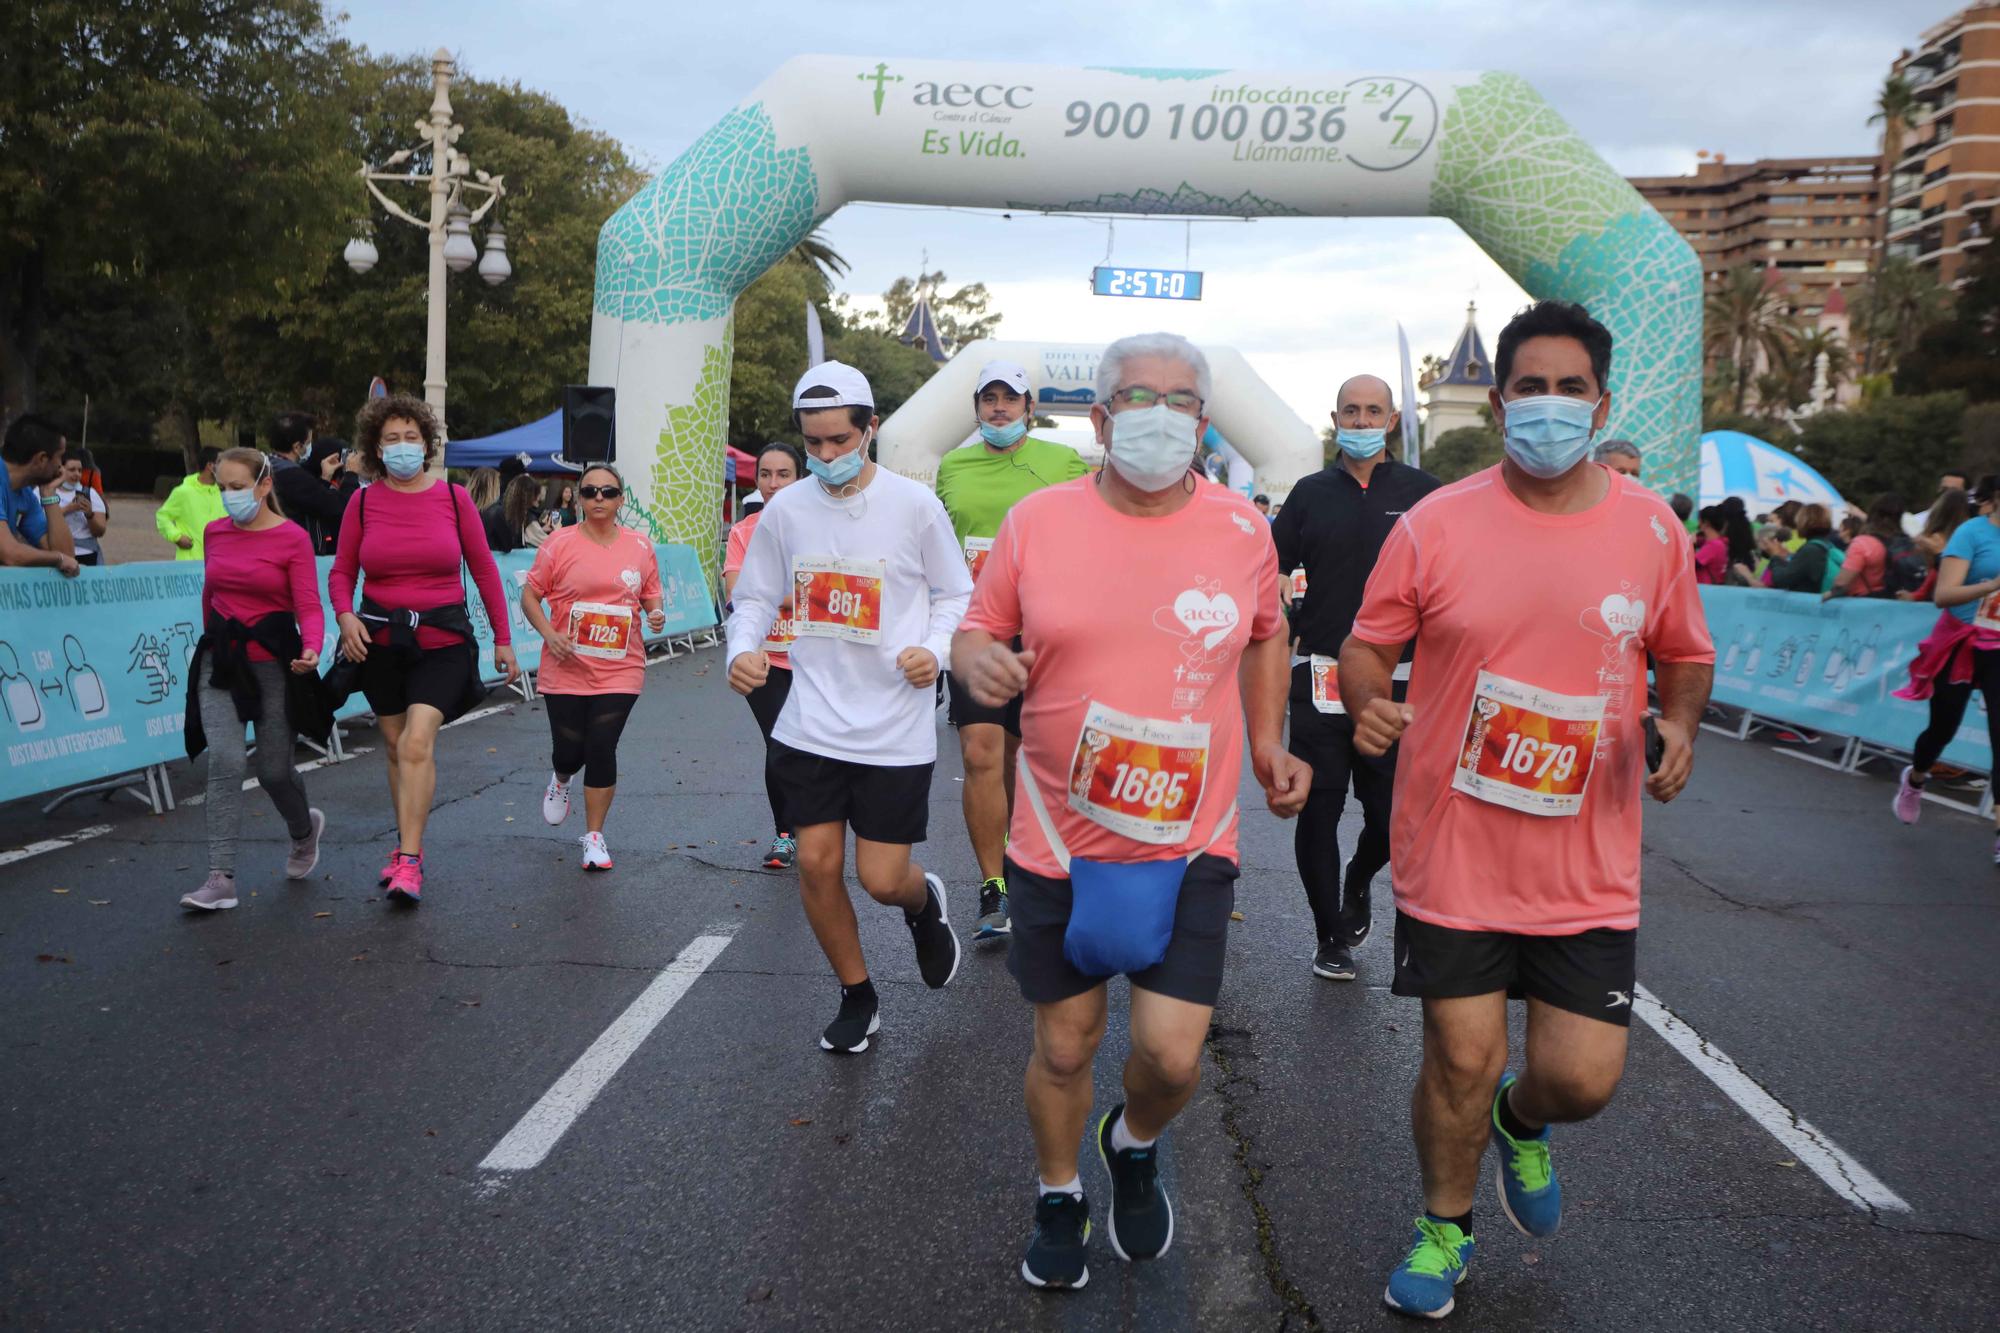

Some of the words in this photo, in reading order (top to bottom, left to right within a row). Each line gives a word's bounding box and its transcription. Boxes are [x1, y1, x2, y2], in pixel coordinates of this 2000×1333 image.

[913, 81, 1034, 109] aecc
[1210, 84, 1351, 105] infocáncer
[1363, 82, 1395, 98] 24
[933, 110, 965, 123] Contra
[969, 111, 978, 123] el
[1064, 100, 1150, 139] 900
[1168, 103, 1248, 142] 100
[1260, 105, 1347, 143] 036
[1390, 115, 1413, 145] 7
[921, 129, 950, 154] Es
[959, 130, 1026, 158] Vida.
[1232, 140, 1343, 163] Llámame.
[33, 580, 72, 608] COVID
[74, 579, 90, 606] DE
[91, 575, 153, 604] SEGURIDAD
[154, 575, 164, 600] E
[163, 573, 204, 599] HIGIEN
[828, 588, 862, 619] 861
[1184, 608, 1235, 625] aecc
[588, 623, 619, 643] 1126
[8, 736, 57, 767] DISTANCIA
[56, 725, 127, 759] INTERPERSONAL
[1500, 732, 1578, 782] 1679
[1110, 762, 1189, 810] 1685
